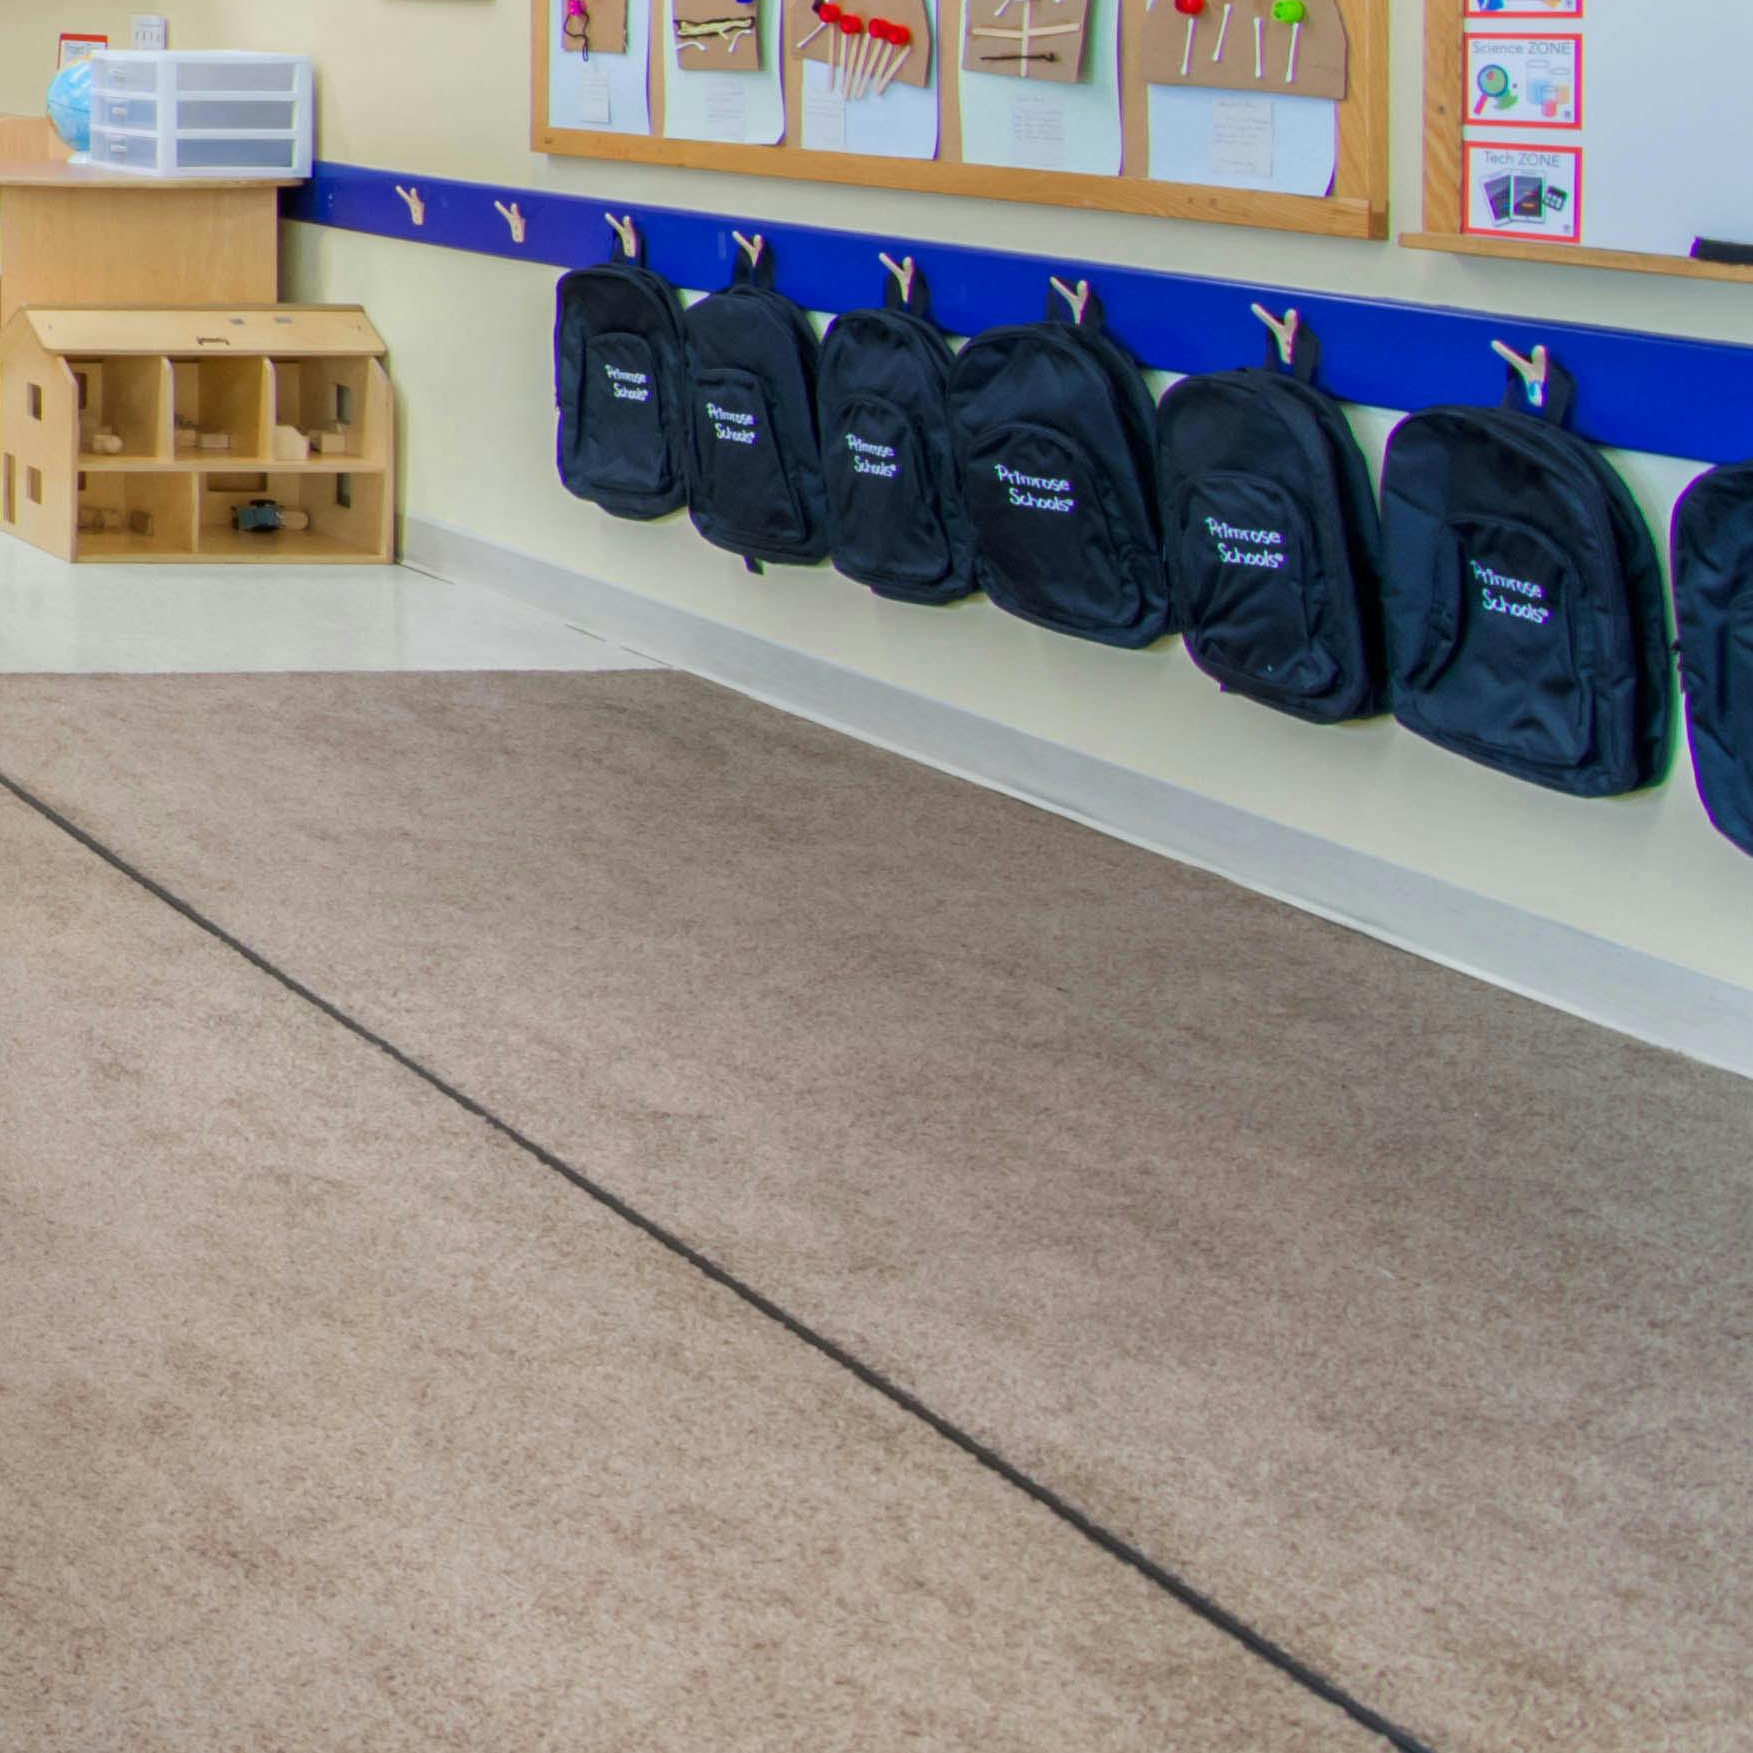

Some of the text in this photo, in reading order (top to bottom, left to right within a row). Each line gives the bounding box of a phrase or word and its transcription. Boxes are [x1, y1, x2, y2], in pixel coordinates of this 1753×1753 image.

[1471, 40, 1572, 56] Science ZONE
[1483, 149, 1561, 169] Tech ZONE
[604, 362, 648, 385] Primrose
[706, 401, 756, 427] Primrose
[845, 432, 895, 459] Primrose
[995, 463, 1072, 494] Primrose
[1204, 515, 1282, 546] Primrose
[1469, 559, 1545, 600] Primrose
